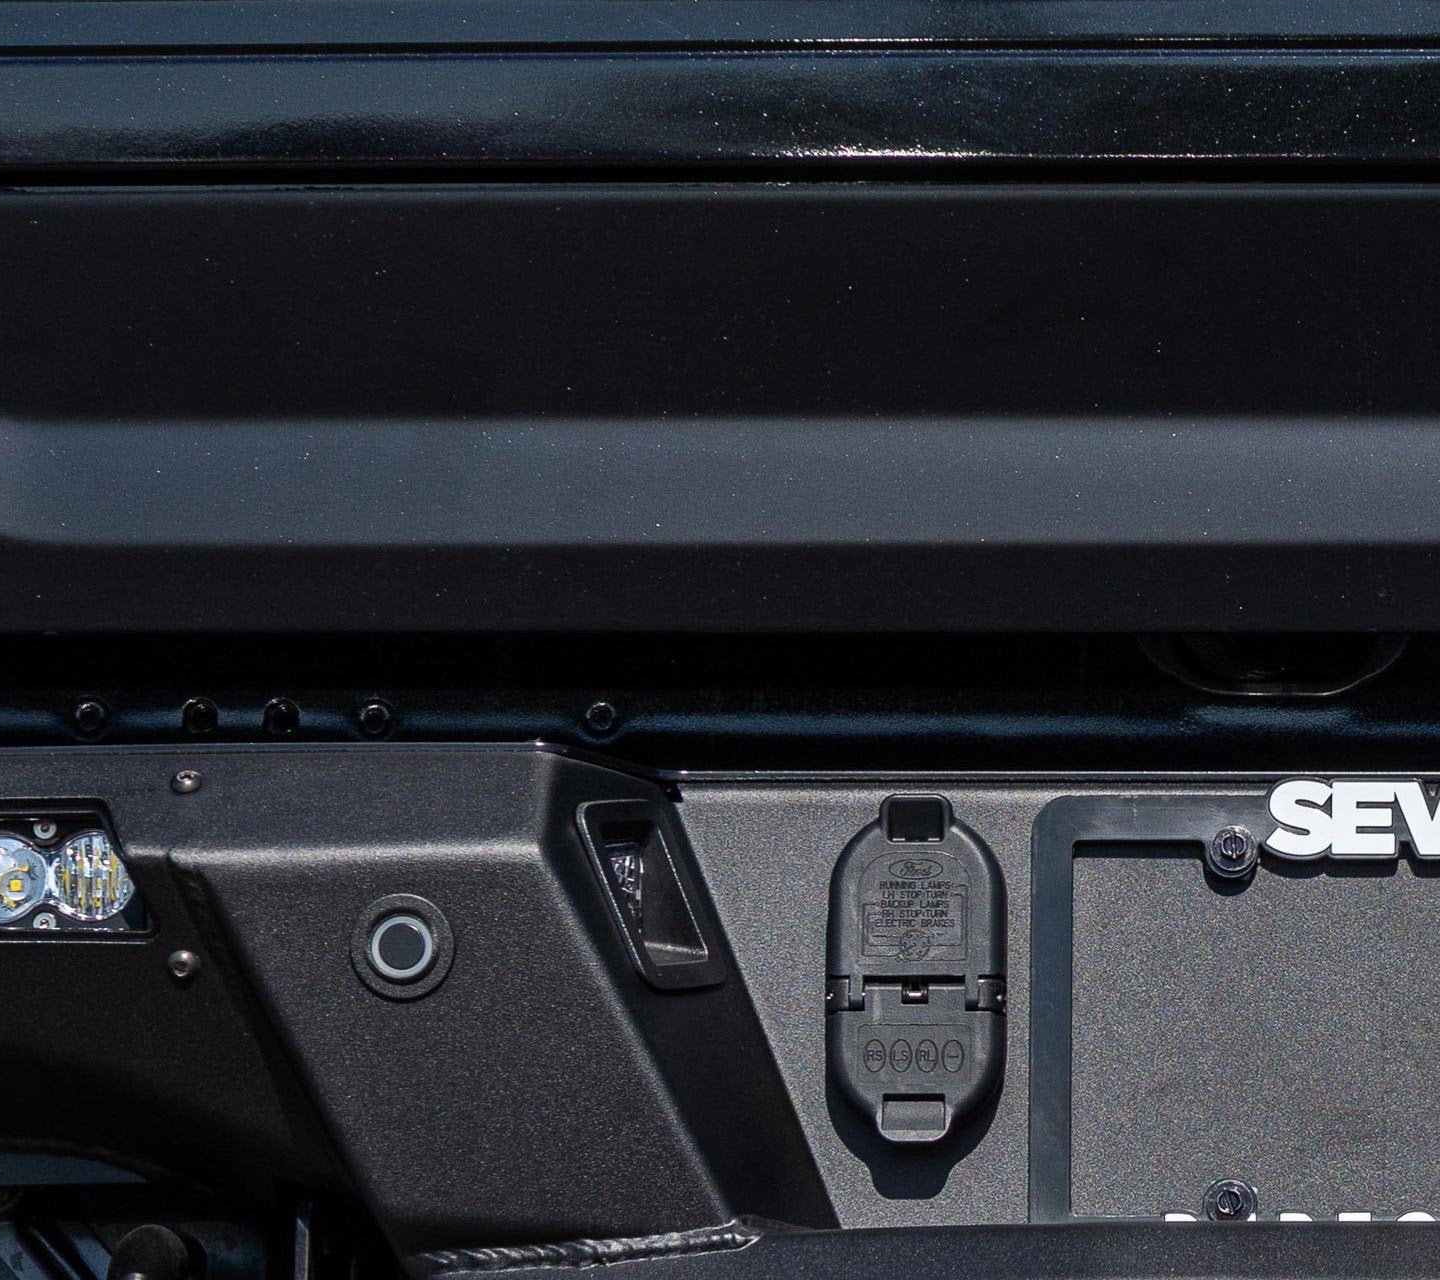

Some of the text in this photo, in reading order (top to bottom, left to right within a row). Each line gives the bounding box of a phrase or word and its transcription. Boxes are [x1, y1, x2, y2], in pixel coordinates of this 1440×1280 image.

[880, 881, 951, 890] RUNNING LAMPS
[882, 890, 895, 899] LH
[881, 900, 950, 909] BACKUP LAMPS
[882, 909, 895, 918] RH
[875, 919, 956, 928] ELECTRIC BRAKES
[867, 1050, 936, 1061] RS LS RL
